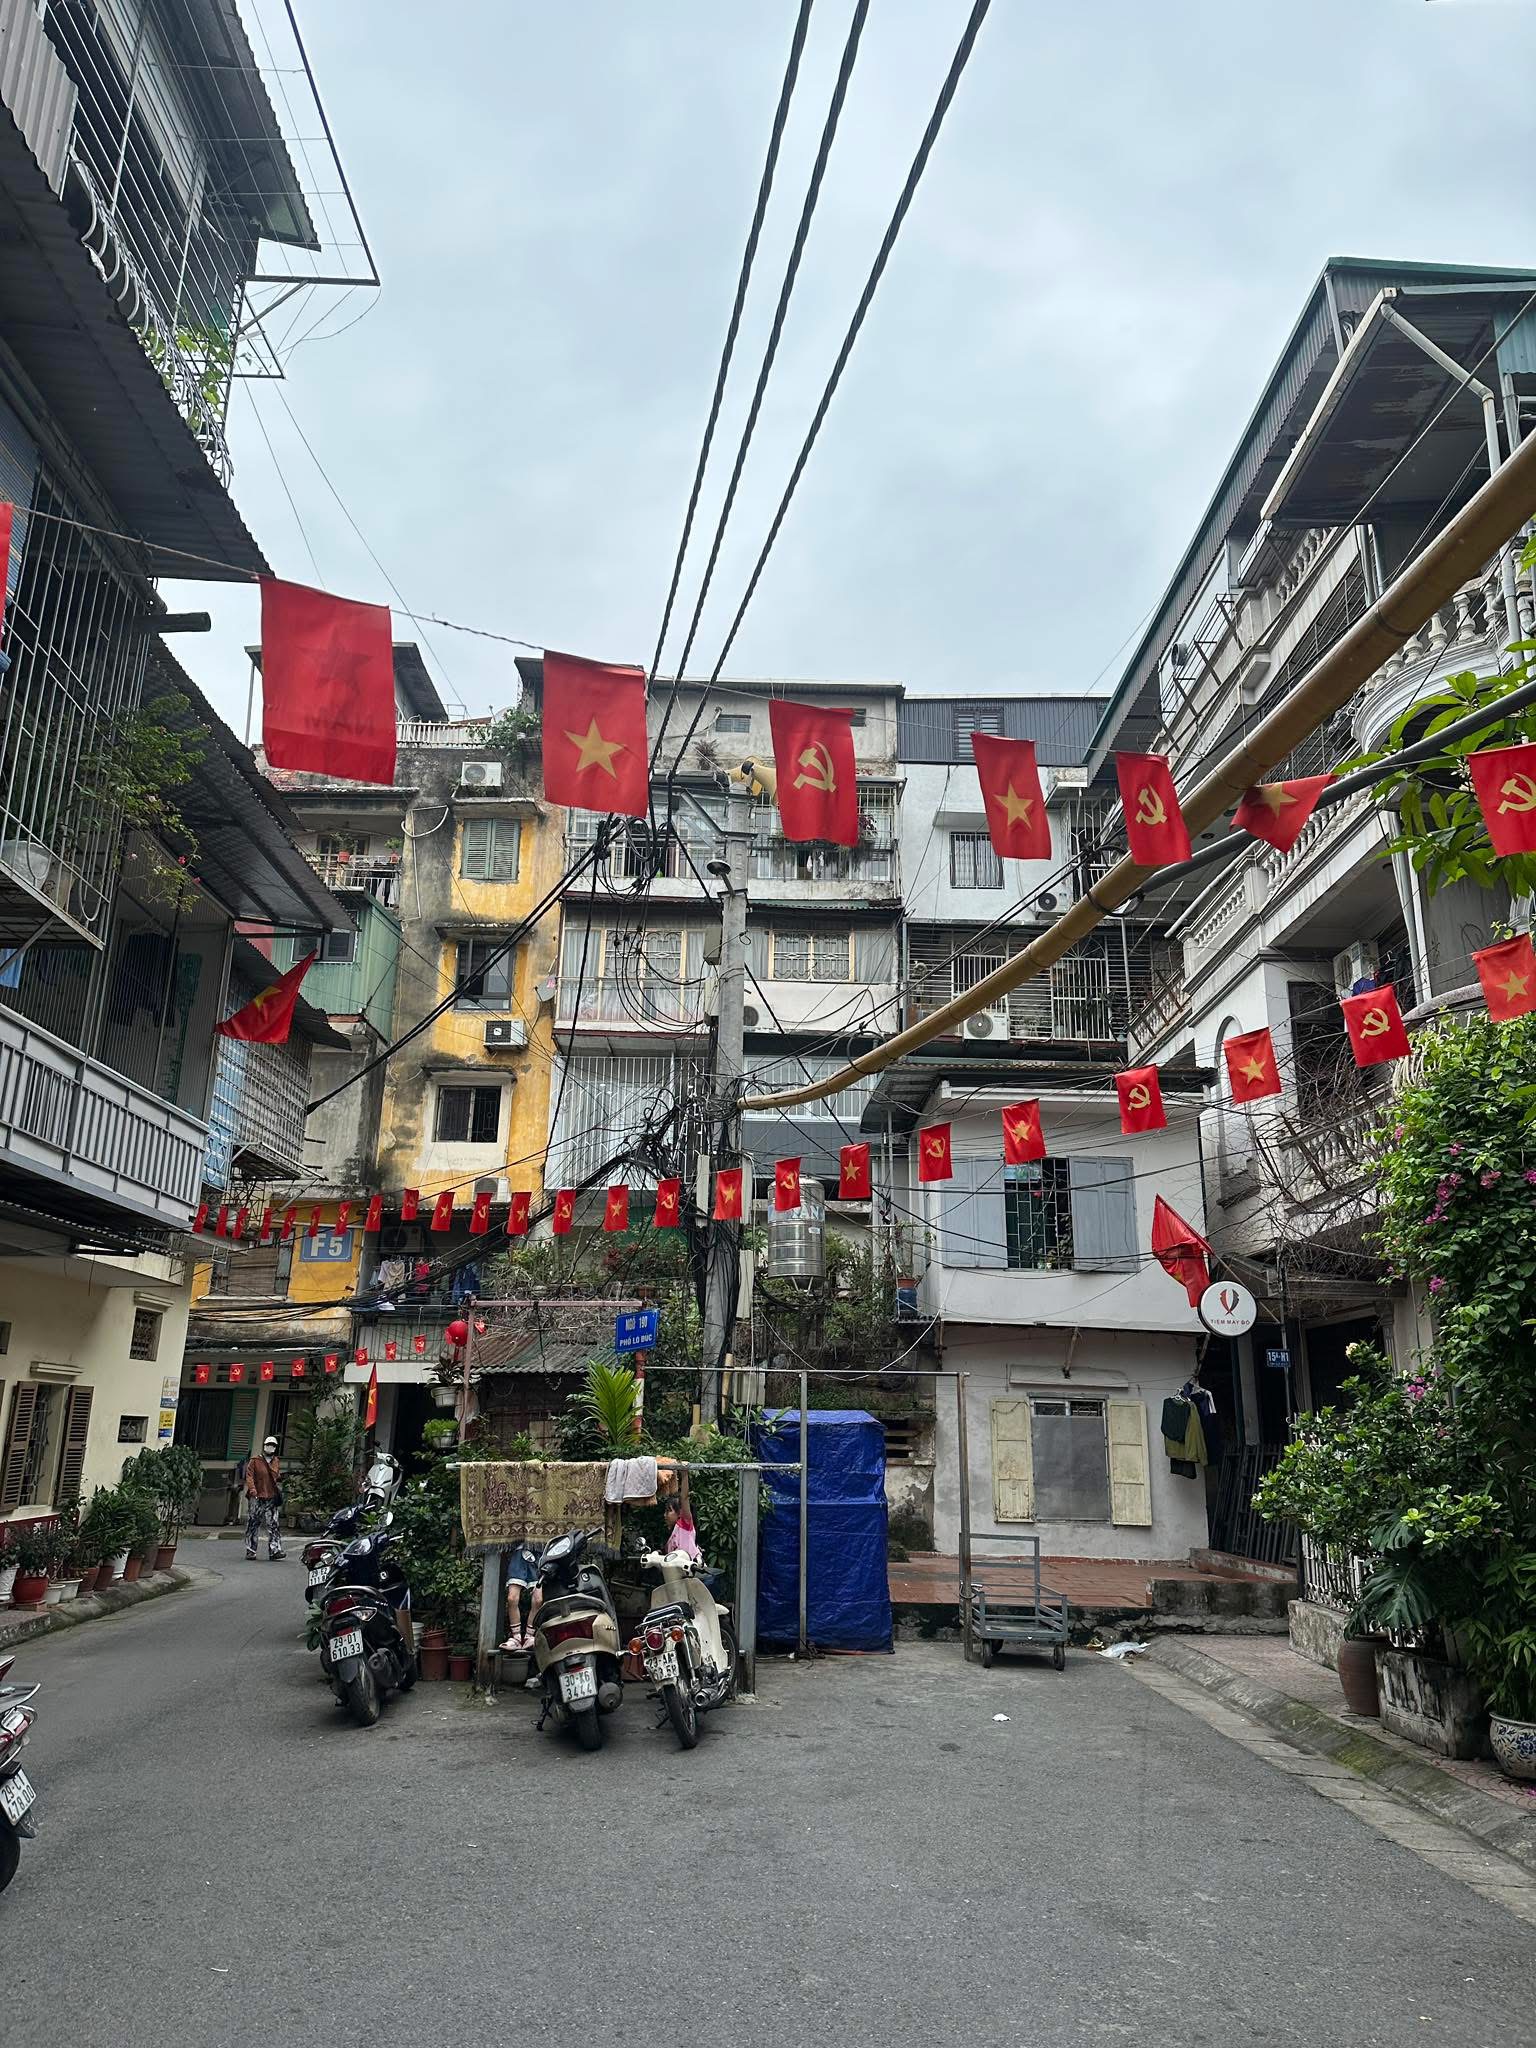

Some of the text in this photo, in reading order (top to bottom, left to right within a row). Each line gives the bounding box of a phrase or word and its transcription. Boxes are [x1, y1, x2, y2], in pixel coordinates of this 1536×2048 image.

[311, 1233, 343, 1257] F5
[332, 1642, 361, 1660] 610.33
[565, 1670, 590, 1687] 30-K6
[567, 1683, 592, 1700] 3444
[8, 1784, 35, 1820] 478.00
